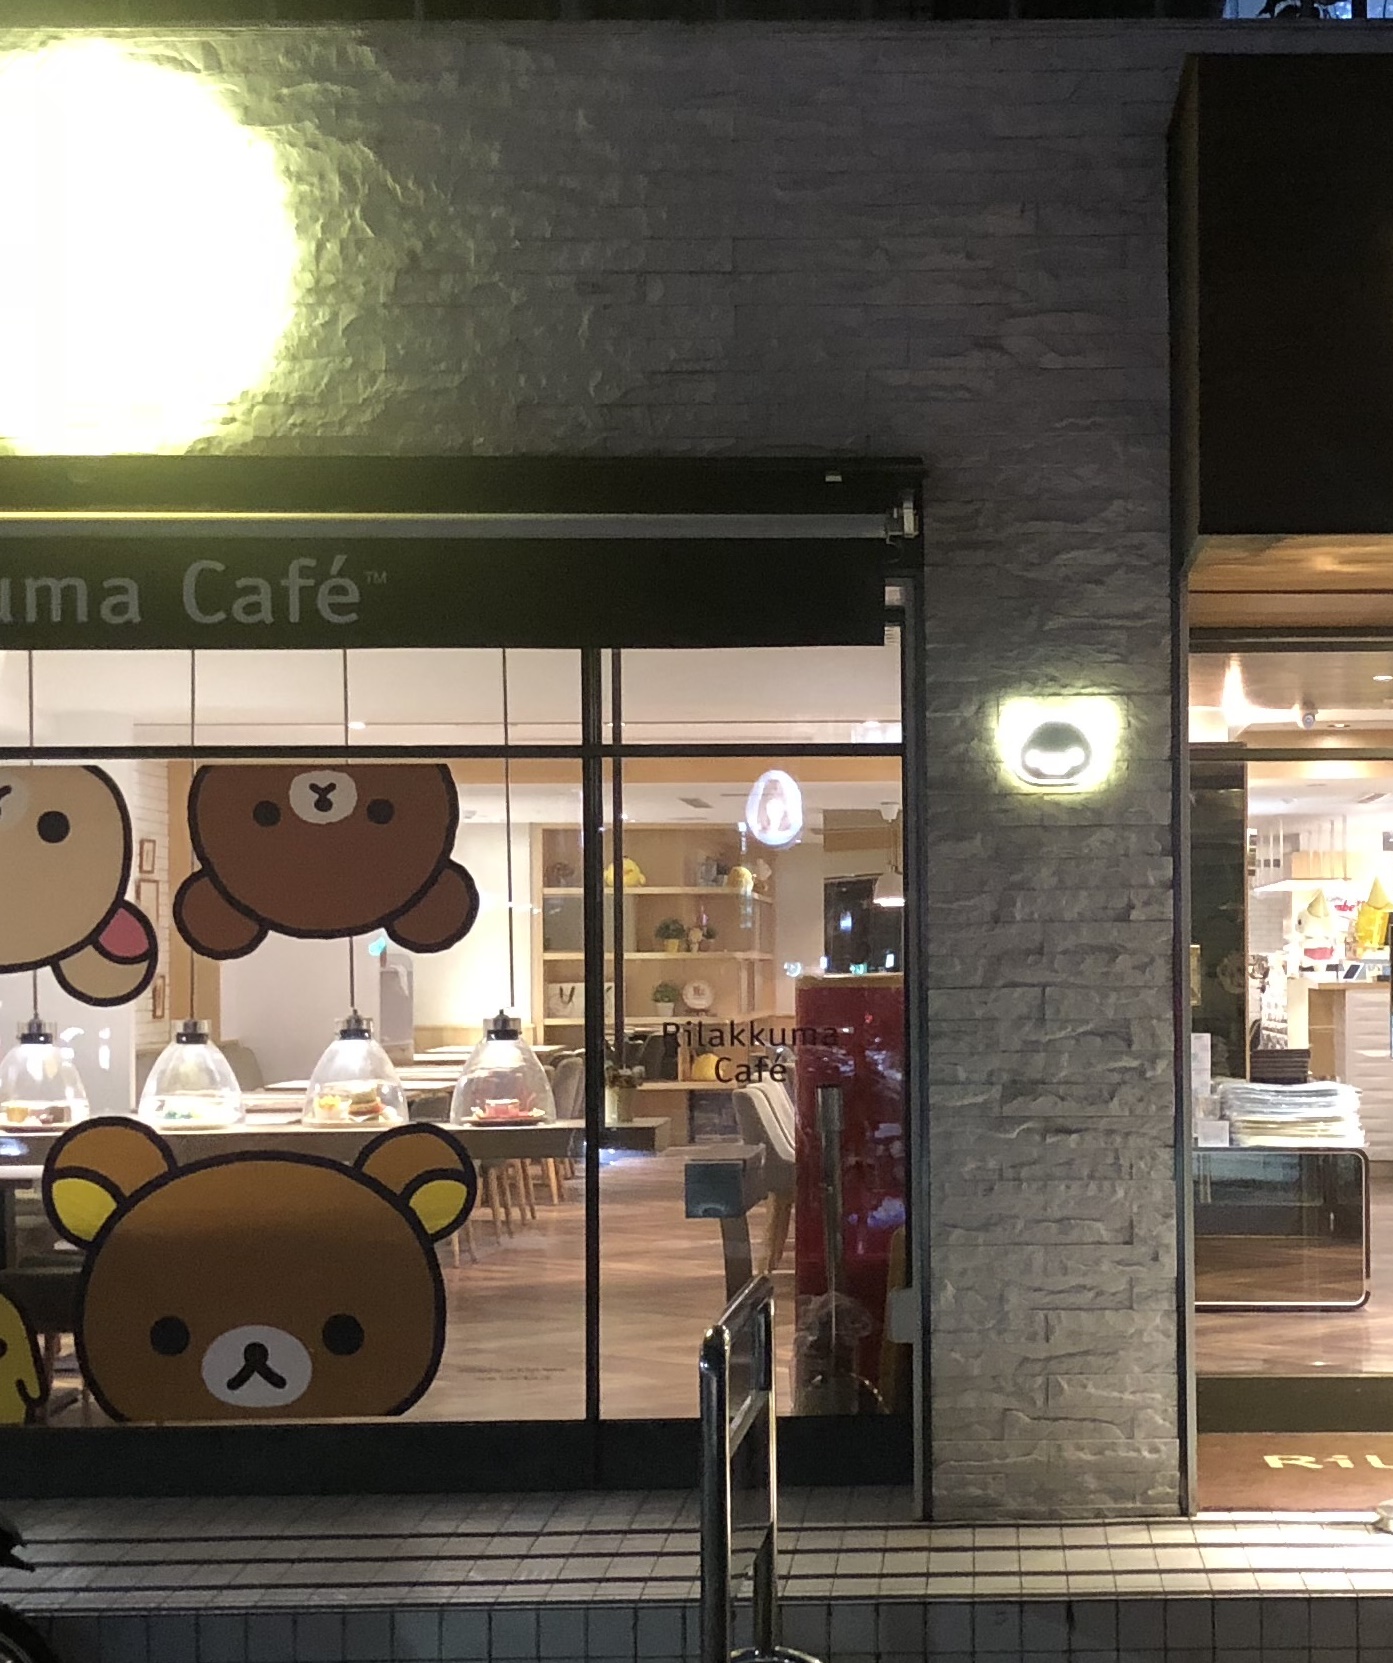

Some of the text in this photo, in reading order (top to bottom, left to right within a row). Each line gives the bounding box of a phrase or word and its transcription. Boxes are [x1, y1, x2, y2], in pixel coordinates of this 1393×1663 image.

[182, 554, 361, 624] Café
[662, 1020, 840, 1049] Rilakkuma
[714, 1053, 788, 1084] Café
